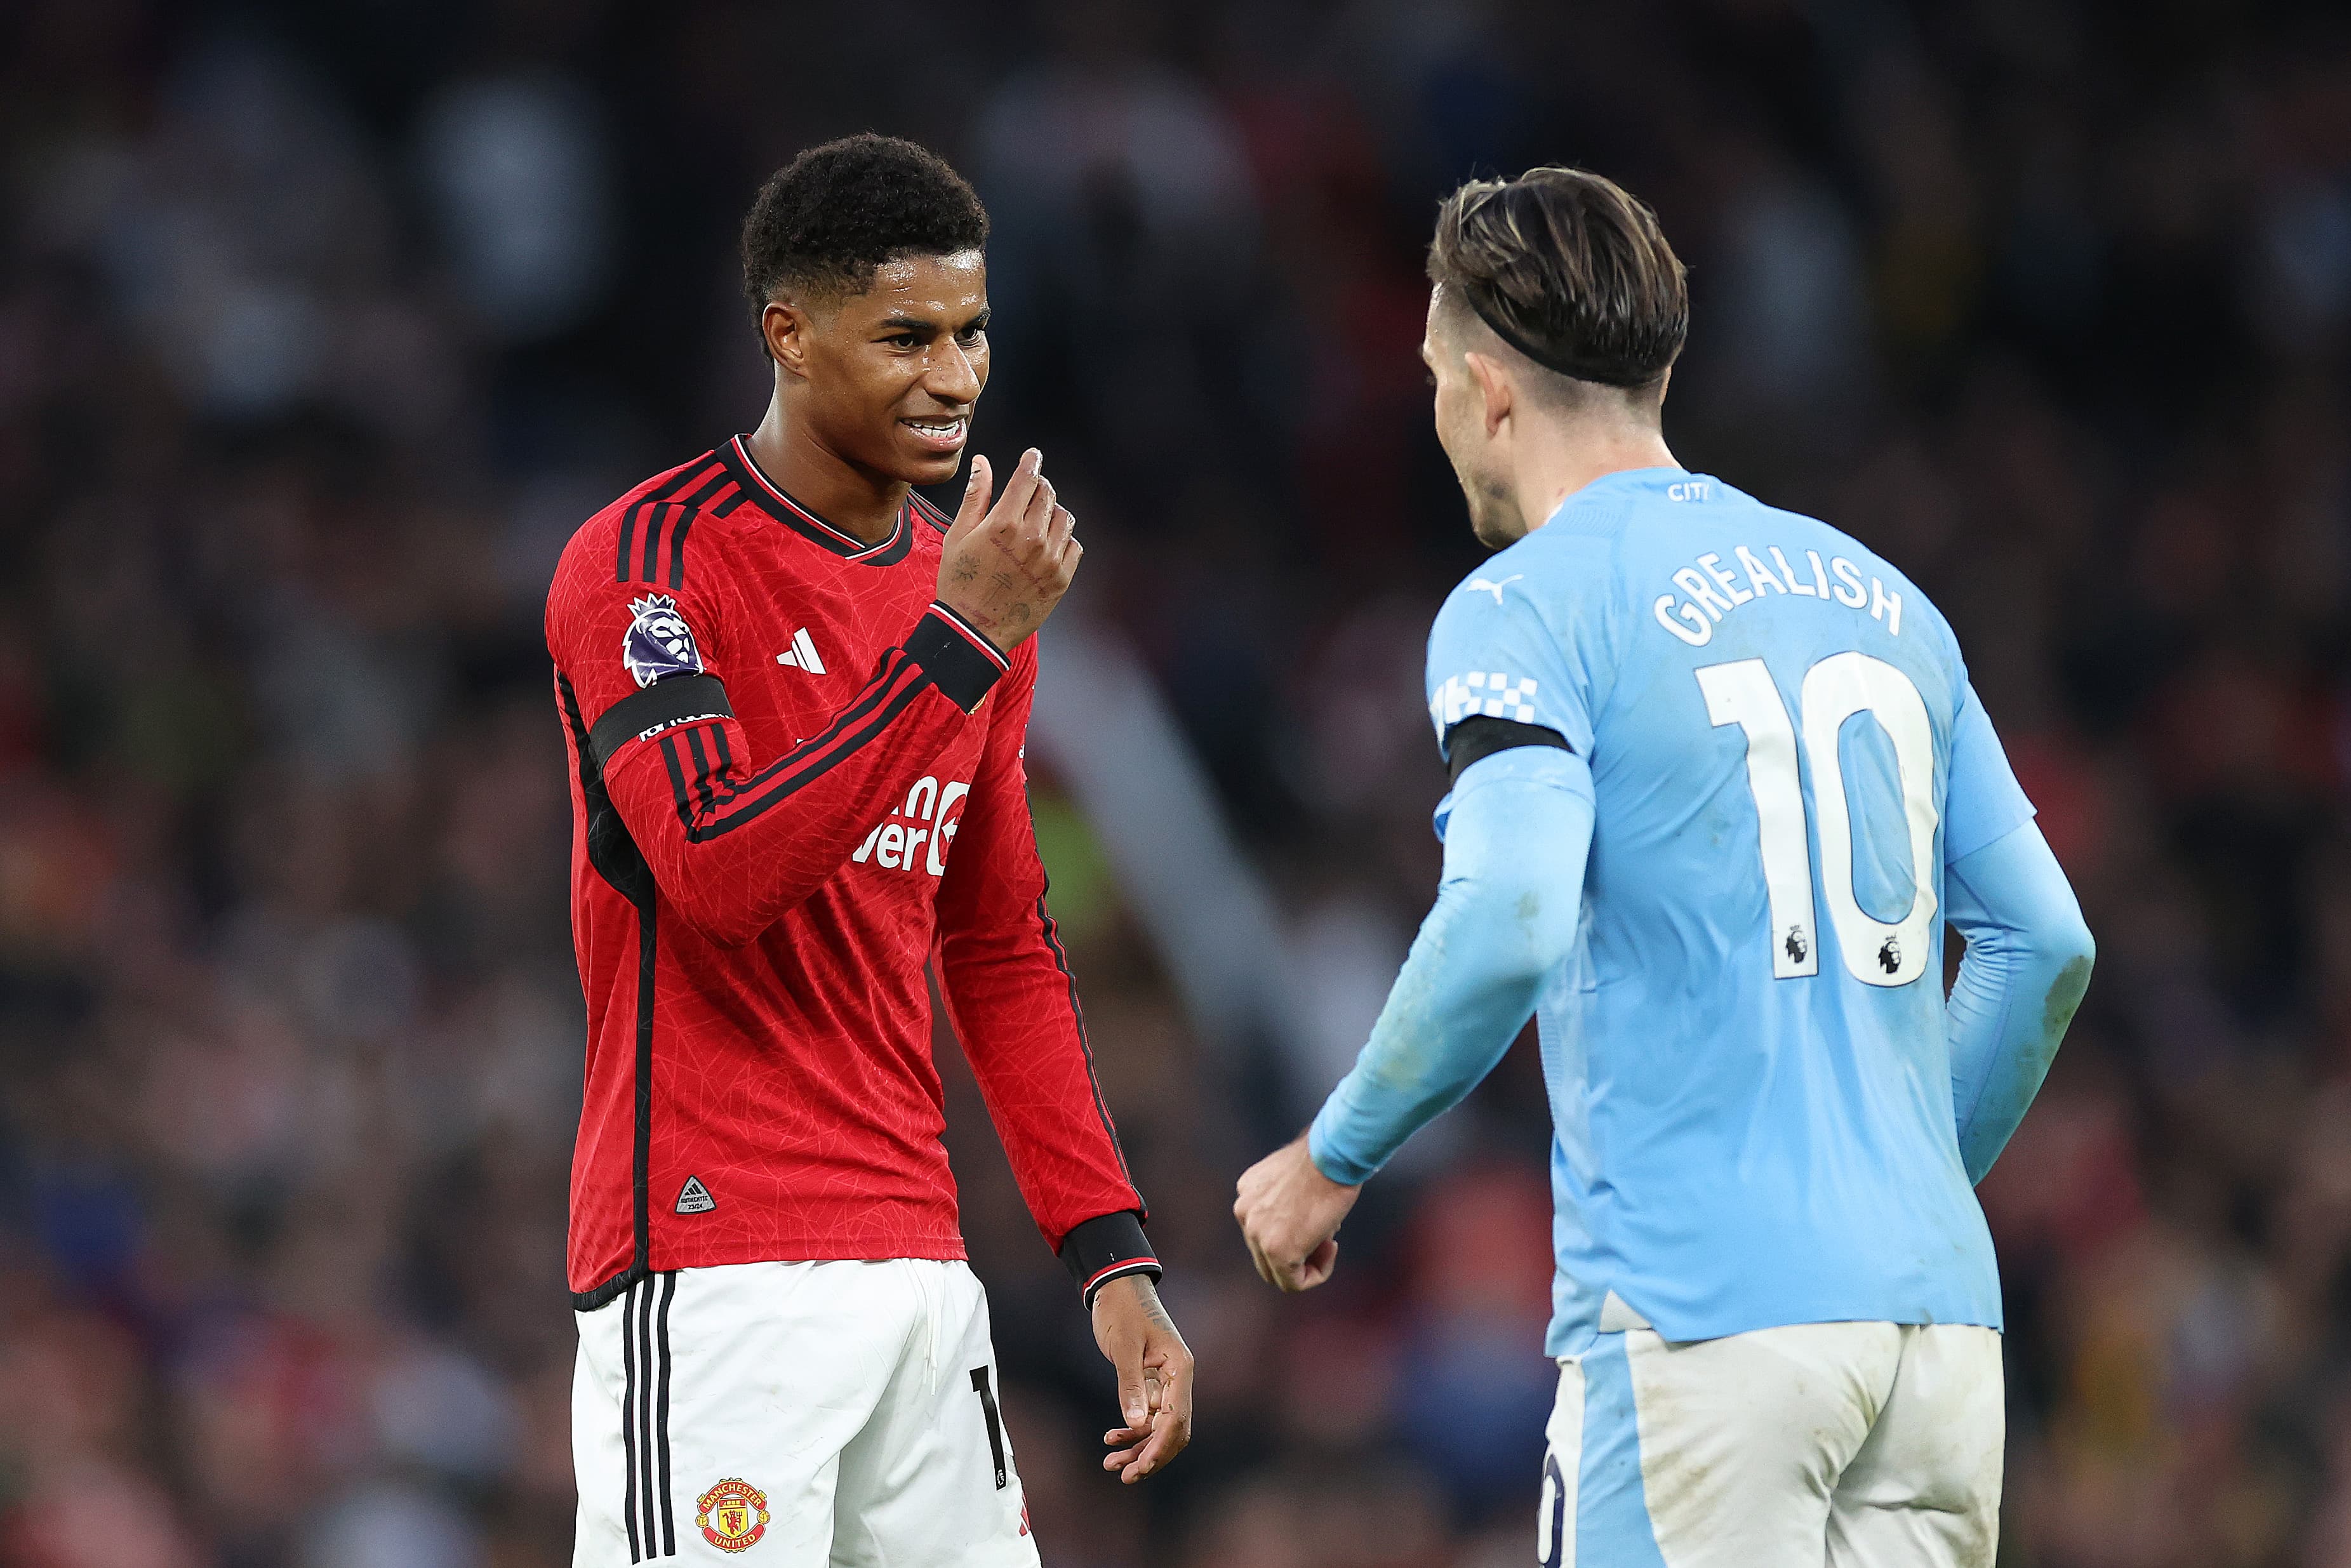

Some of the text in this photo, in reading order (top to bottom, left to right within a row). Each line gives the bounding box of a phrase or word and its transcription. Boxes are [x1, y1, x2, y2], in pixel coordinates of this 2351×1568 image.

[1653, 545, 1903, 648] GREALISH
[1693, 649, 1940, 988] 10
[703, 1484, 762, 1510] MANCHESTER
[714, 1533, 756, 1548] UNITED
